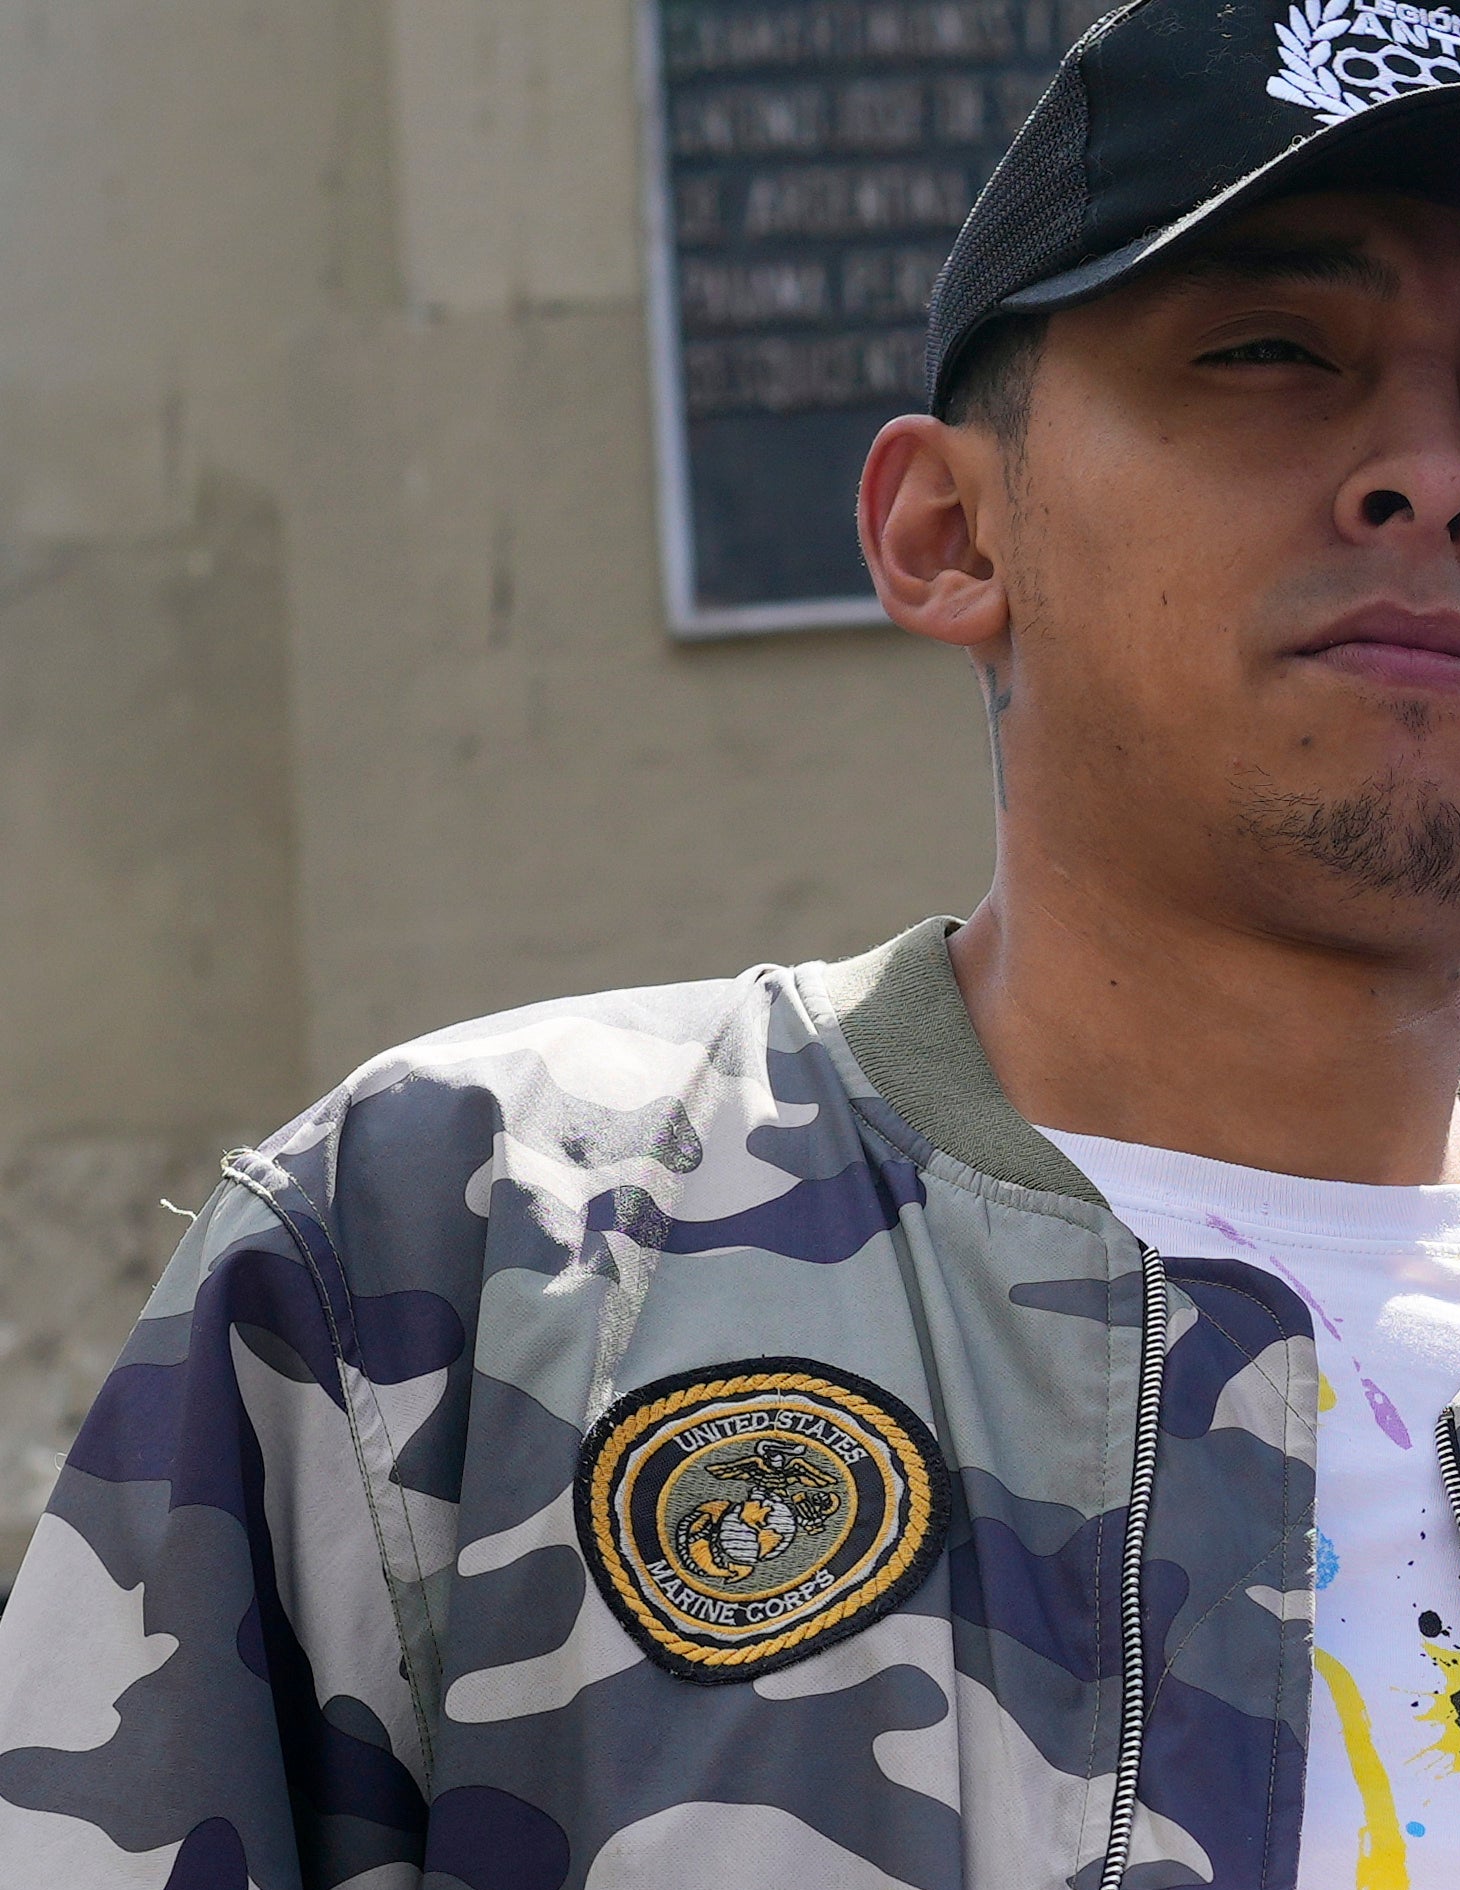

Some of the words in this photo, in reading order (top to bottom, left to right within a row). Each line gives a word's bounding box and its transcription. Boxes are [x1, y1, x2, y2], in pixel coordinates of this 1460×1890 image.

[672, 1412, 770, 1454] UNITED
[778, 1409, 869, 1464] STATES
[646, 1558, 738, 1626] MARINE
[745, 1568, 836, 1624] CORPS
